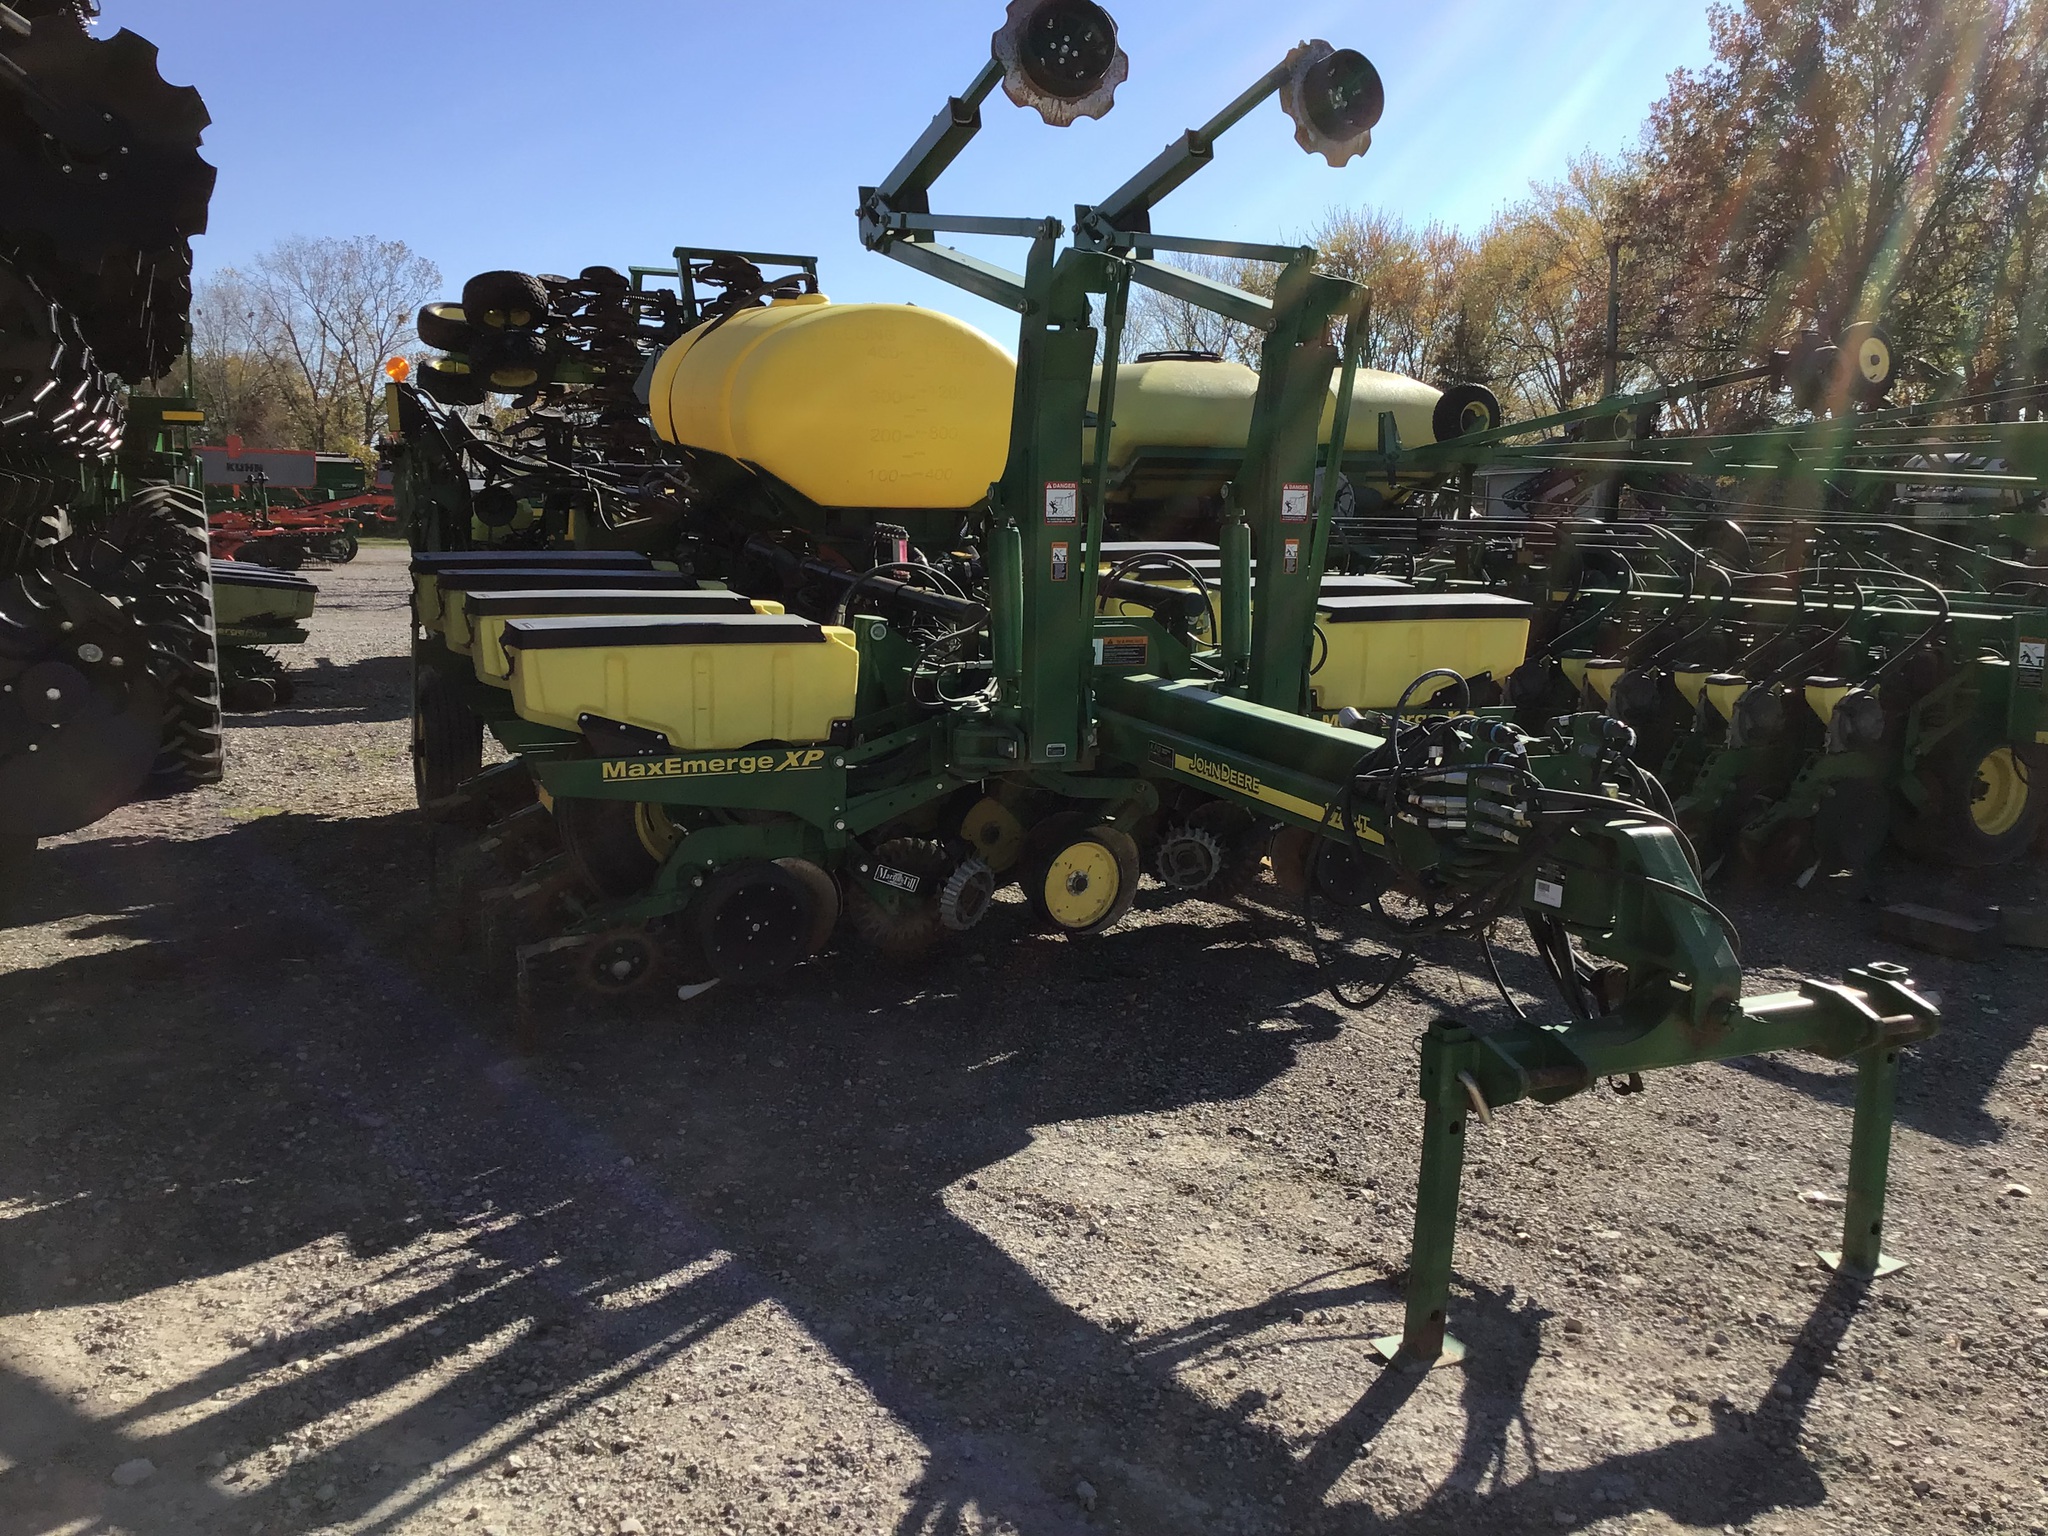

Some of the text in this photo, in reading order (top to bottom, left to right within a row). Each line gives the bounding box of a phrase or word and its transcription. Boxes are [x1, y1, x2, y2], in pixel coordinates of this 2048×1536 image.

[870, 428, 902, 442] 200
[929, 426, 959, 440] 800
[226, 462, 264, 472] KUHN
[867, 469, 899, 482] 100
[602, 749, 825, 779] MaxEmerge XP
